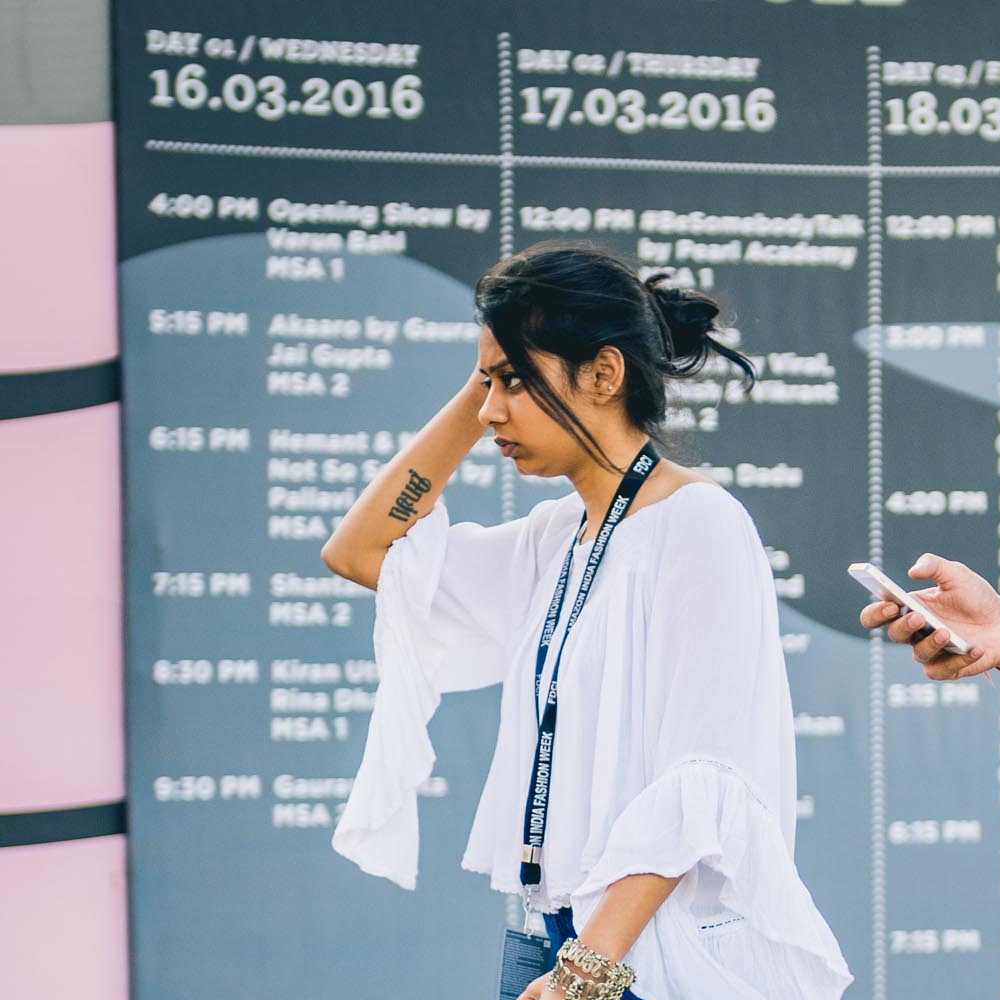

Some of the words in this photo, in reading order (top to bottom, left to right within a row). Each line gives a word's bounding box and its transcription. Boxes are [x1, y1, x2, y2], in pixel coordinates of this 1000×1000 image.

[146, 29, 199, 55] DAY
[259, 38, 420, 66] WEDNESDAY
[517, 49, 571, 73] DAY
[627, 52, 761, 81] THURSDAY
[882, 61, 935, 85] DAY
[149, 64, 424, 120] 16.03.2016
[520, 86, 777, 134] 17.03.2016
[149, 192, 213, 218] 4:00
[218, 197, 258, 219] PM
[268, 198, 379, 228] Opening
[382, 203, 453, 228] Show
[456, 205, 492, 233] by
[519, 207, 590, 231] 12:00
[594, 209, 635, 232] PM
[956, 215, 995, 238] PM
[744, 241, 857, 270] Academy
[149, 310, 202, 335] 5:15
[207, 312, 248, 335] PM
[365, 316, 398, 343] by
[403, 317, 478, 341] Gaura
[312, 344, 392, 369] Gupta
[331, 372, 350, 397] 2
[149, 426, 203, 450] 6:15
[208, 428, 249, 450] PM
[322, 460, 357, 482] So
[633, 455, 653, 475] FDCI
[581, 564, 597, 592] INDIA
[589, 523, 614, 564] FASHION
[607, 494, 630, 526] WEEK
[209, 574, 249, 596] PM
[333, 603, 351, 626] 2
[541, 619, 556, 647] WEEK
[218, 661, 258, 684] PM
[548, 681, 558, 705] FDCI
[539, 731, 553, 762] WEEK
[220, 777, 261, 799] PM
[534, 761, 550, 807] FASHION
[530, 807, 546, 837] INDIA
